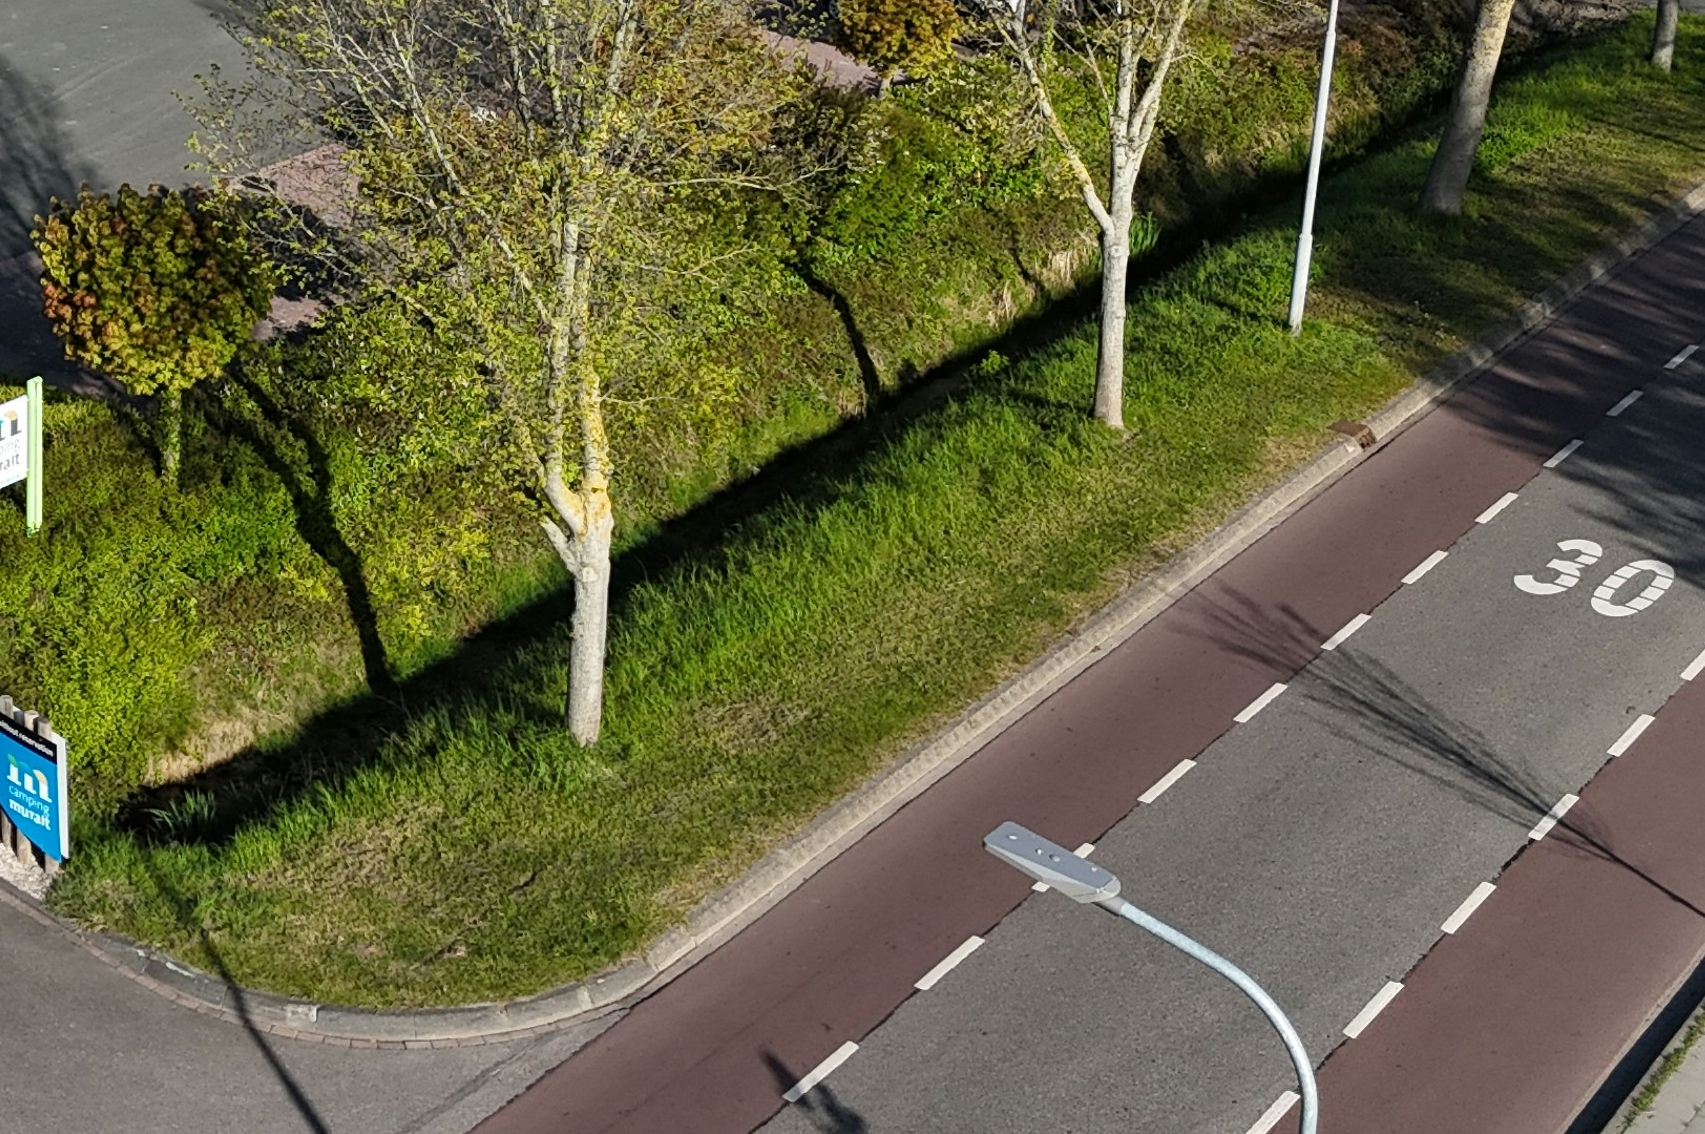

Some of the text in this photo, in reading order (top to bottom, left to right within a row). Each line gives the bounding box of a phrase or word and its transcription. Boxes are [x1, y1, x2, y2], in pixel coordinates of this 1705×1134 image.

[1514, 539, 1675, 617] 30
[9, 785, 50, 817] camping
[9, 799, 52, 831] muralt
